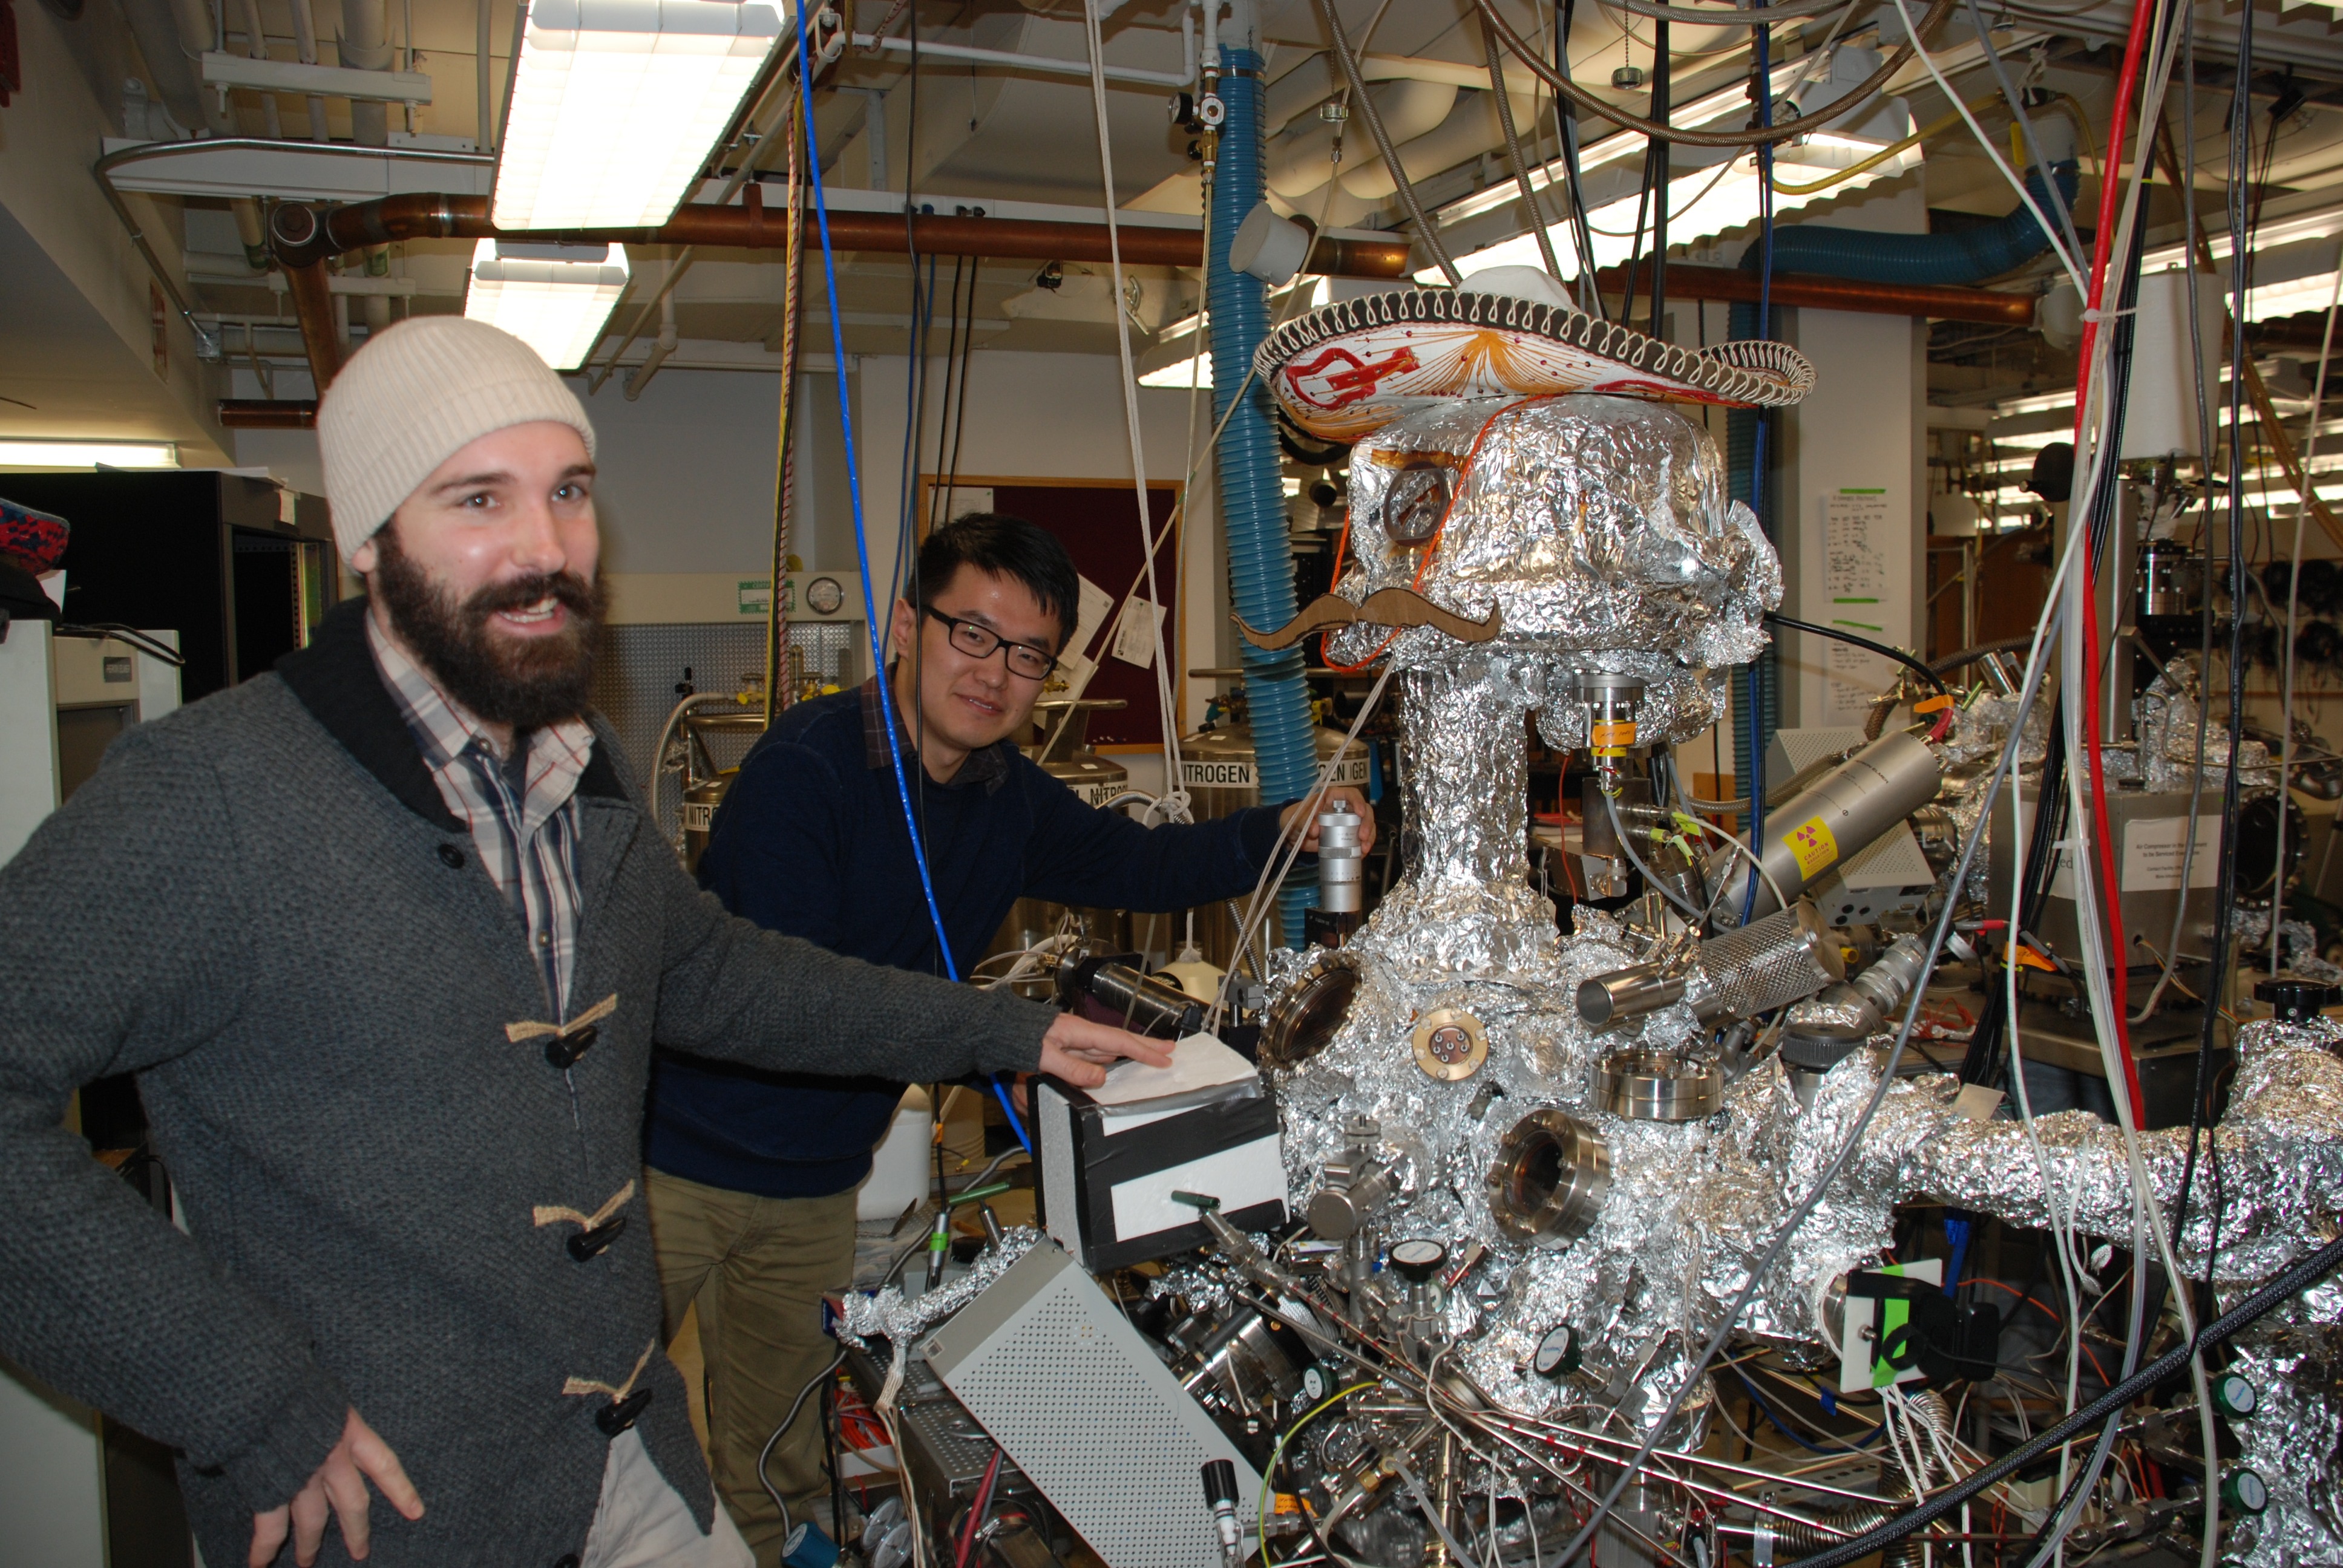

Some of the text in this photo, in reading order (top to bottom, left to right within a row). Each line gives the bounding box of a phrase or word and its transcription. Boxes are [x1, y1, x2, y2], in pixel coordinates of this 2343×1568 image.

[1176, 763, 1250, 783] ITROGEN
[1349, 762, 1367, 780] GEN
[1804, 842, 1829, 860] CAUTION
